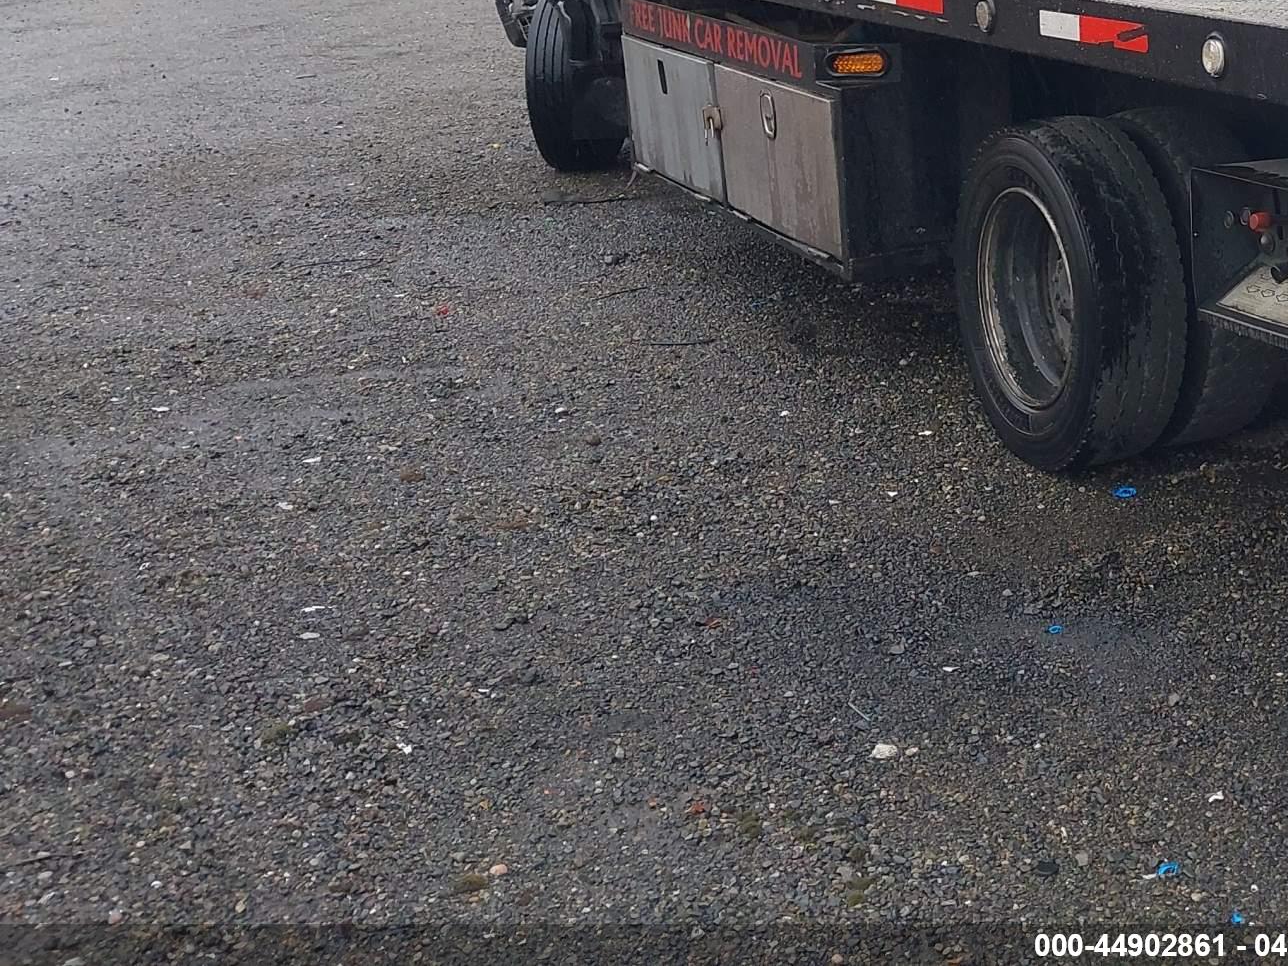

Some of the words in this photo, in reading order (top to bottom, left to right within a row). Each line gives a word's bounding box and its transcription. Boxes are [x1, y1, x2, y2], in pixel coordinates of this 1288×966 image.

[657, 8, 692, 43] JUNK
[694, 18, 724, 54] CAR
[727, 26, 803, 78] REMOVAL
